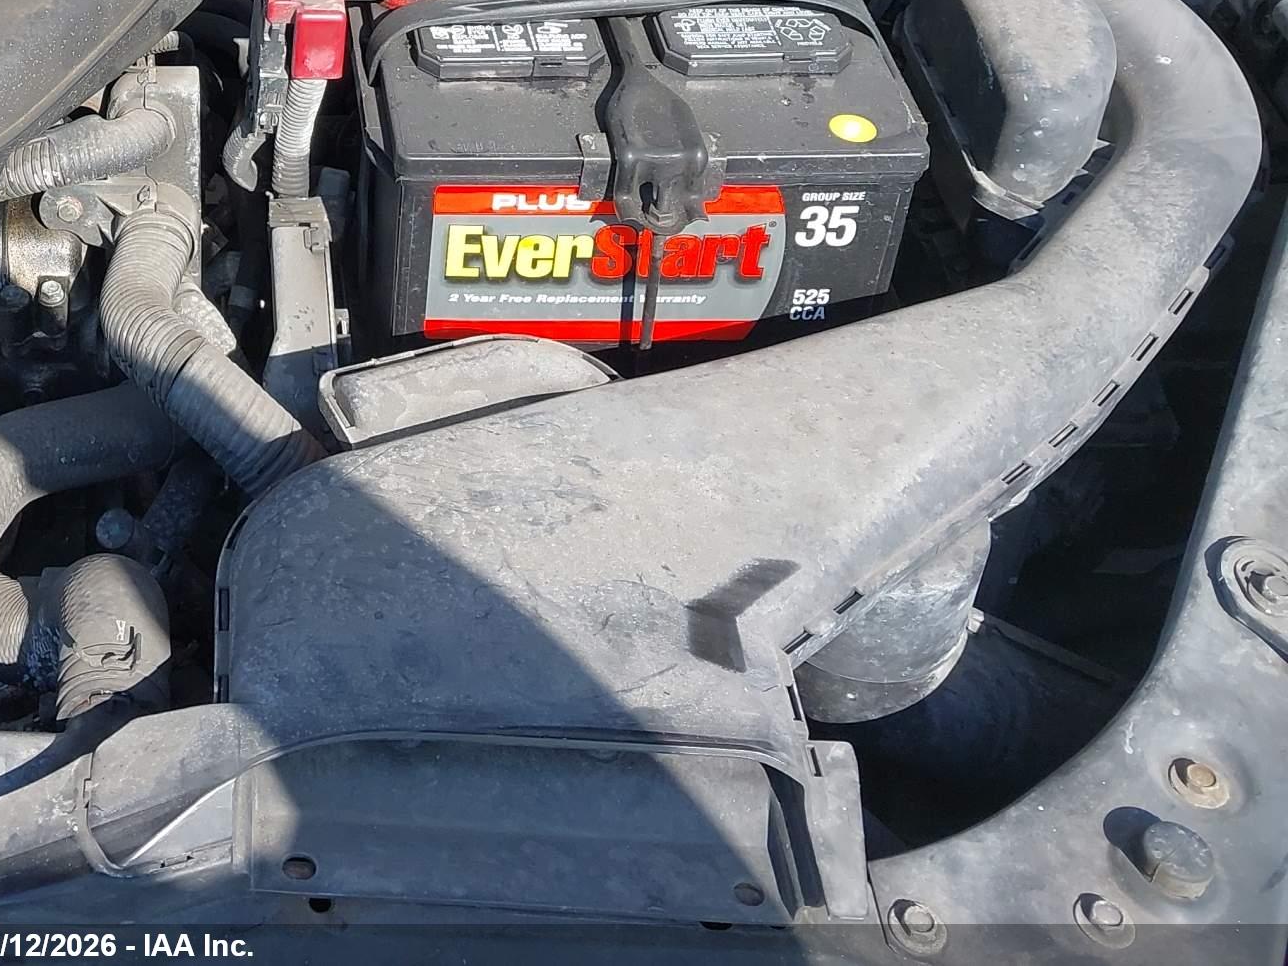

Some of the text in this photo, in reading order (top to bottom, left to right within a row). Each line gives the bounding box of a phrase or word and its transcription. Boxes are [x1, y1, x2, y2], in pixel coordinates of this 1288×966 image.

[802, 192, 866, 202] GROUP SIZE
[795, 206, 860, 247] 35
[448, 294, 459, 303] 2
[464, 294, 494, 303] Year
[499, 295, 532, 303] Free
[536, 295, 633, 304] Replacement
[793, 289, 831, 304] 525
[790, 306, 825, 320] CCA
